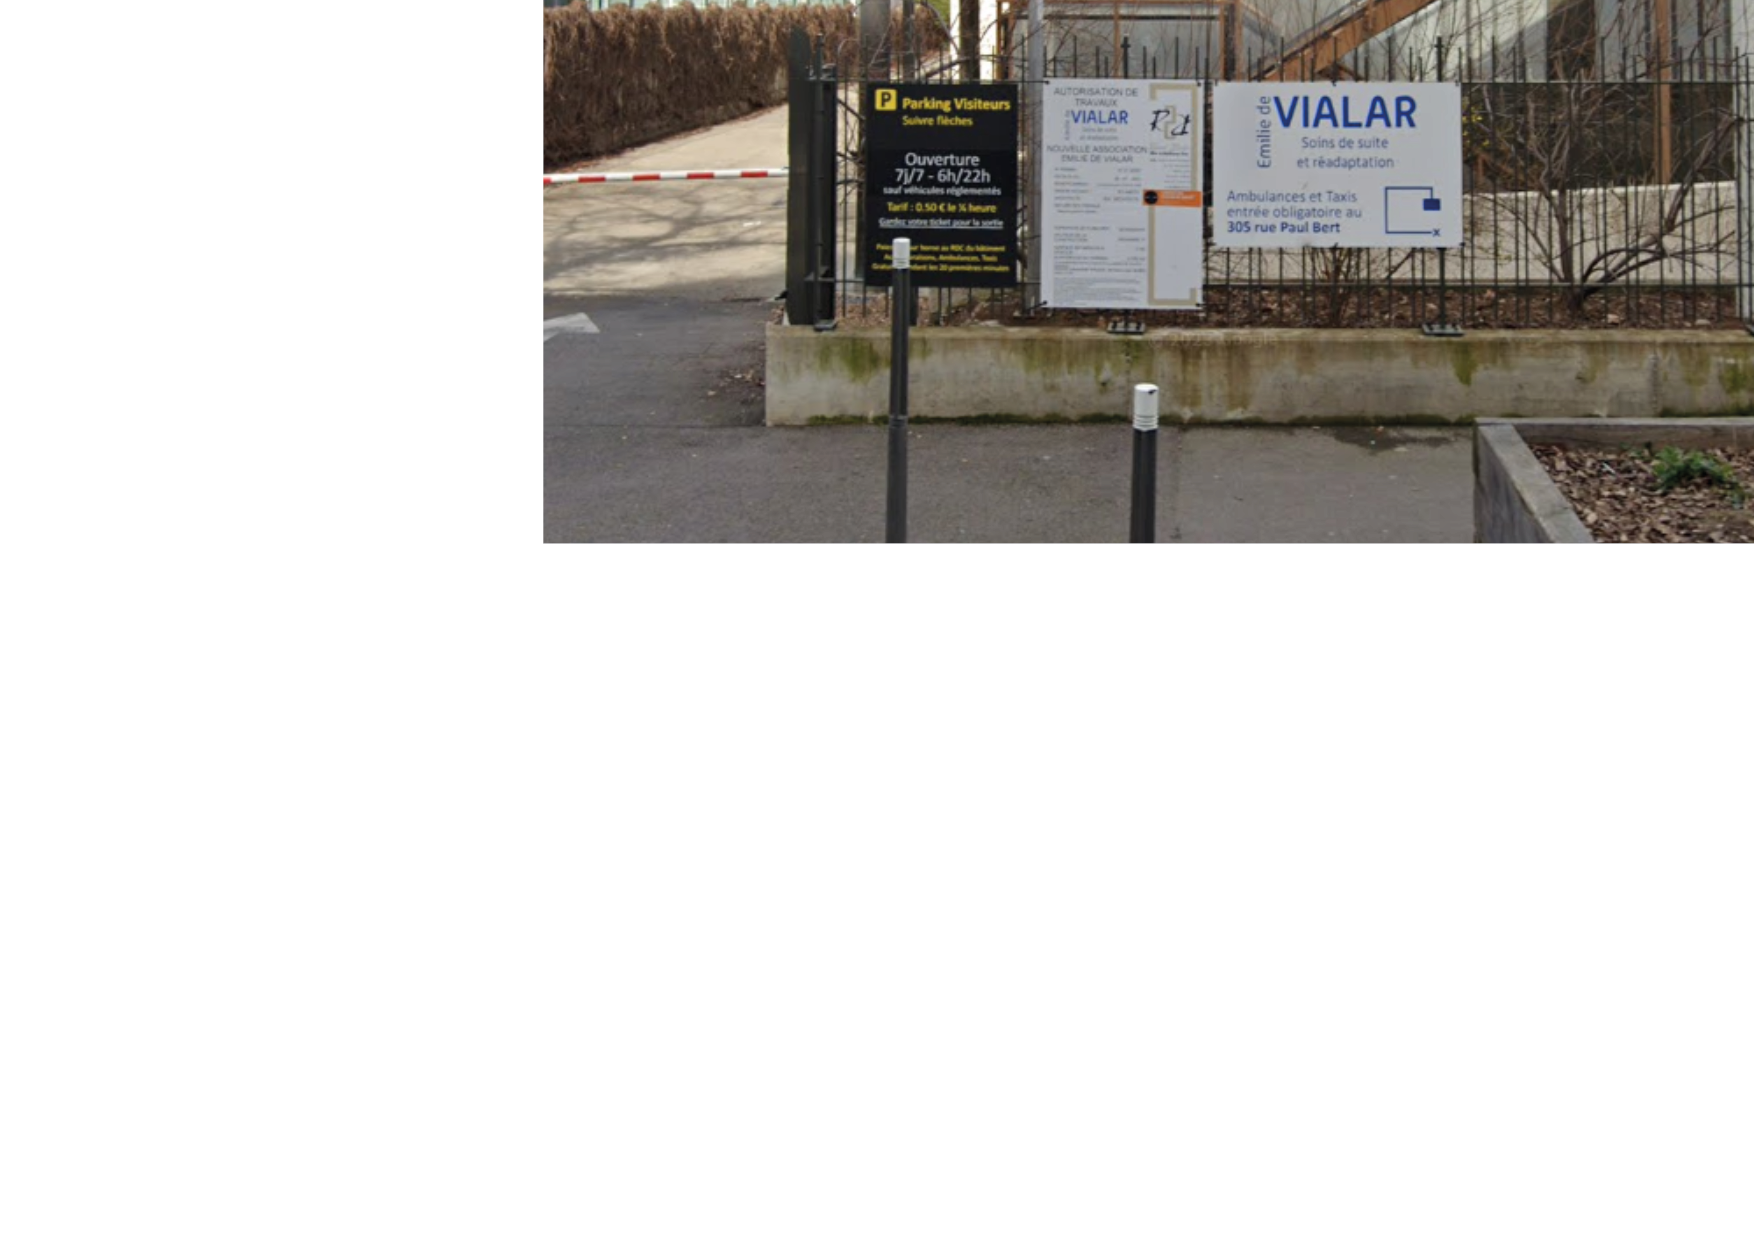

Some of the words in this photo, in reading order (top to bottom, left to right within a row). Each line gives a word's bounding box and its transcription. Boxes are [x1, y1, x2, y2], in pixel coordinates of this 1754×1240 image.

[1053, 88, 1123, 96] AUTORISATION
[1125, 88, 1139, 97] DE
[902, 97, 951, 112] Parking
[954, 97, 1011, 110] Visiteurs
[1075, 98, 1117, 107] TRAVAUX
[1257, 96, 1271, 115] de
[1071, 110, 1129, 125] VIALAR
[1273, 95, 1417, 128] VIALAR
[902, 115, 934, 126] Suivre
[936, 115, 973, 126] flèches
[1047, 145, 1090, 153] NOUVELLE
[1092, 145, 1147, 153] ASSOCIATION
[1257, 119, 1271, 168] Emilie
[1302, 137, 1335, 149] Soins
[1339, 137, 1354, 149] de
[1357, 137, 1389, 149] suite
[905, 152, 980, 166] Ouverture
[1061, 154, 1088, 163] EMILIE
[1090, 154, 1102, 163] DE
[1104, 154, 1133, 163] VIALAR
[1297, 158, 1310, 168] et
[1313, 157, 1394, 170] réadaptation
[895, 168, 924, 185] 7j/7
[937, 168, 991, 184] 6h/22h
[883, 186, 902, 195] sauf
[904, 186, 945, 195] véhicules
[947, 186, 1001, 197] réglementés
[1227, 190, 1305, 202] Ambulances
[1309, 191, 1322, 202] et
[1327, 191, 1357, 202] Taxis
[887, 202, 908, 213] Tarif
[915, 202, 937, 213] 0.50
[939, 202, 946, 213] €
[948, 202, 956, 213] le
[969, 202, 997, 213] heure
[1227, 207, 1269, 218] entrée
[1272, 206, 1342, 220] obligatoire
[1345, 209, 1362, 218] au
[879, 218, 905, 227] Gardez
[908, 219, 928, 227] votre
[930, 218, 951, 227] ticket
[954, 219, 971, 228] pour
[973, 218, 980, 227] la
[982, 218, 1003, 227] sortie
[1227, 221, 1251, 233] 305
[1255, 224, 1276, 233] rue
[1280, 221, 1309, 233] Paul
[1313, 221, 1340, 233] Bert
